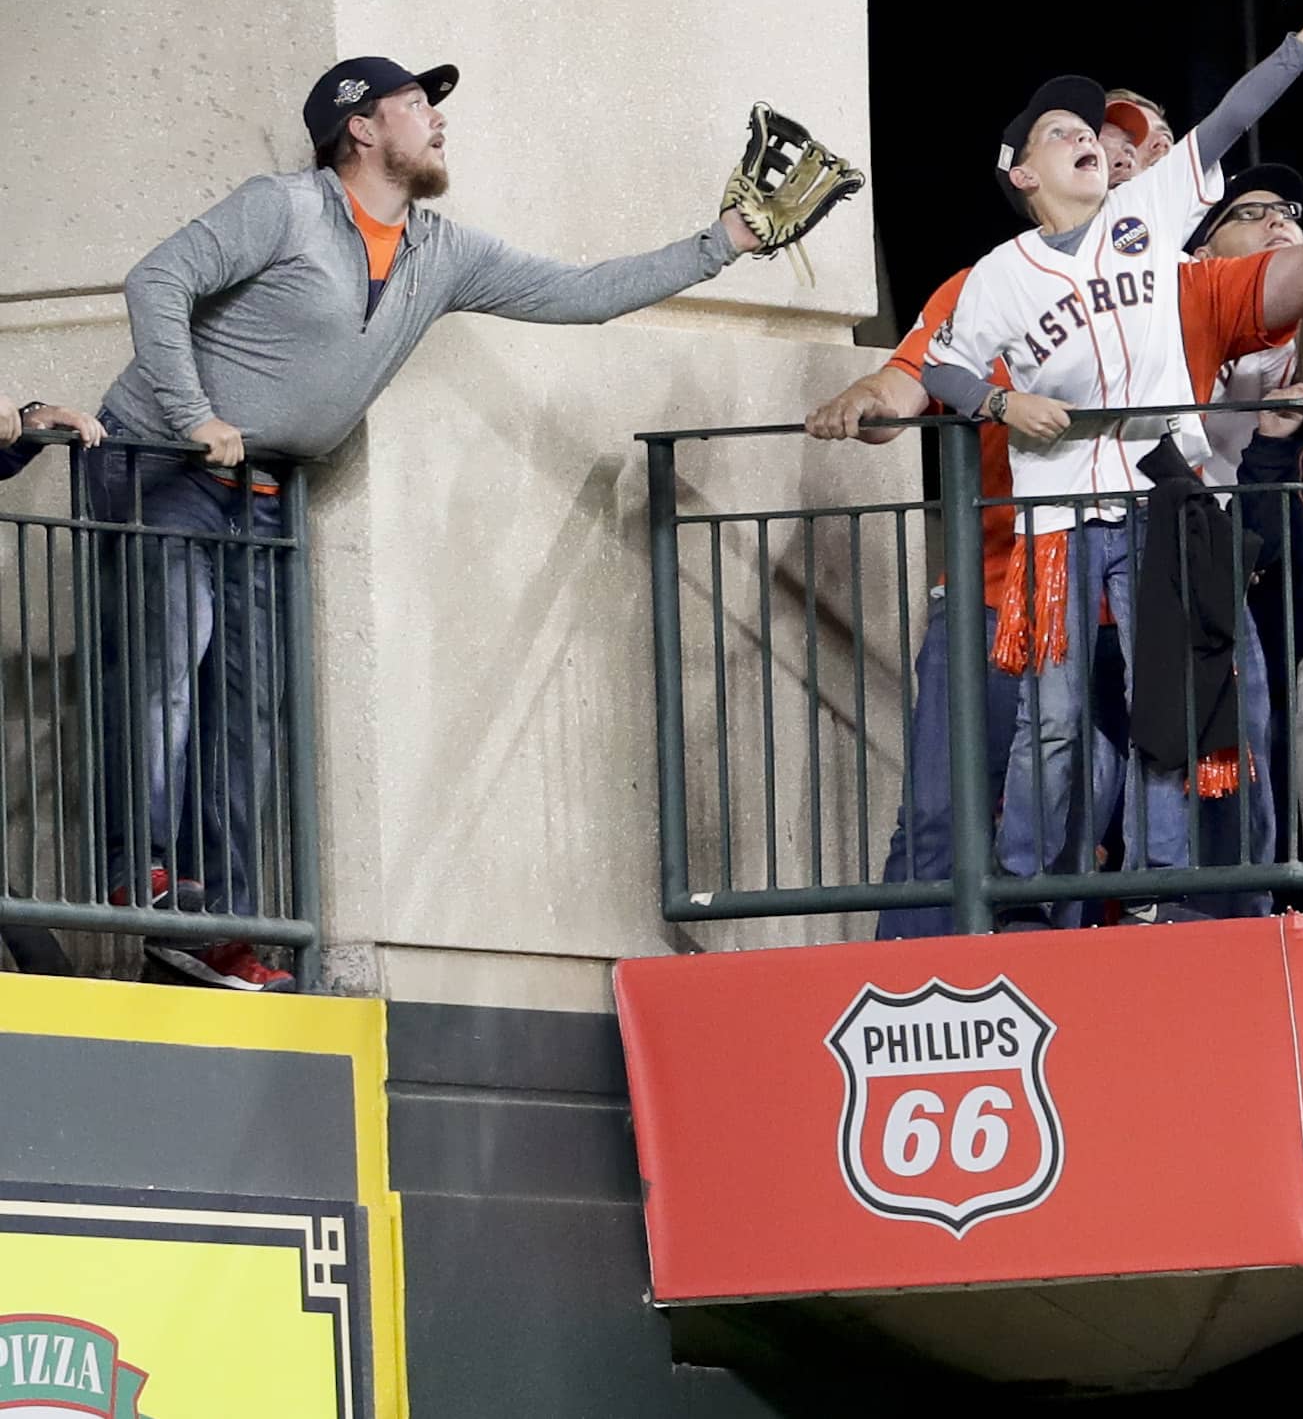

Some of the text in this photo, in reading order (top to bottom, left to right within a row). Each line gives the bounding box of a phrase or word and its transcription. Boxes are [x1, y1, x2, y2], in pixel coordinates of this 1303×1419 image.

[1024, 269, 1155, 367] ASTROS
[863, 1016, 1020, 1066] PHILLIPS
[881, 1085, 1014, 1178] 66
